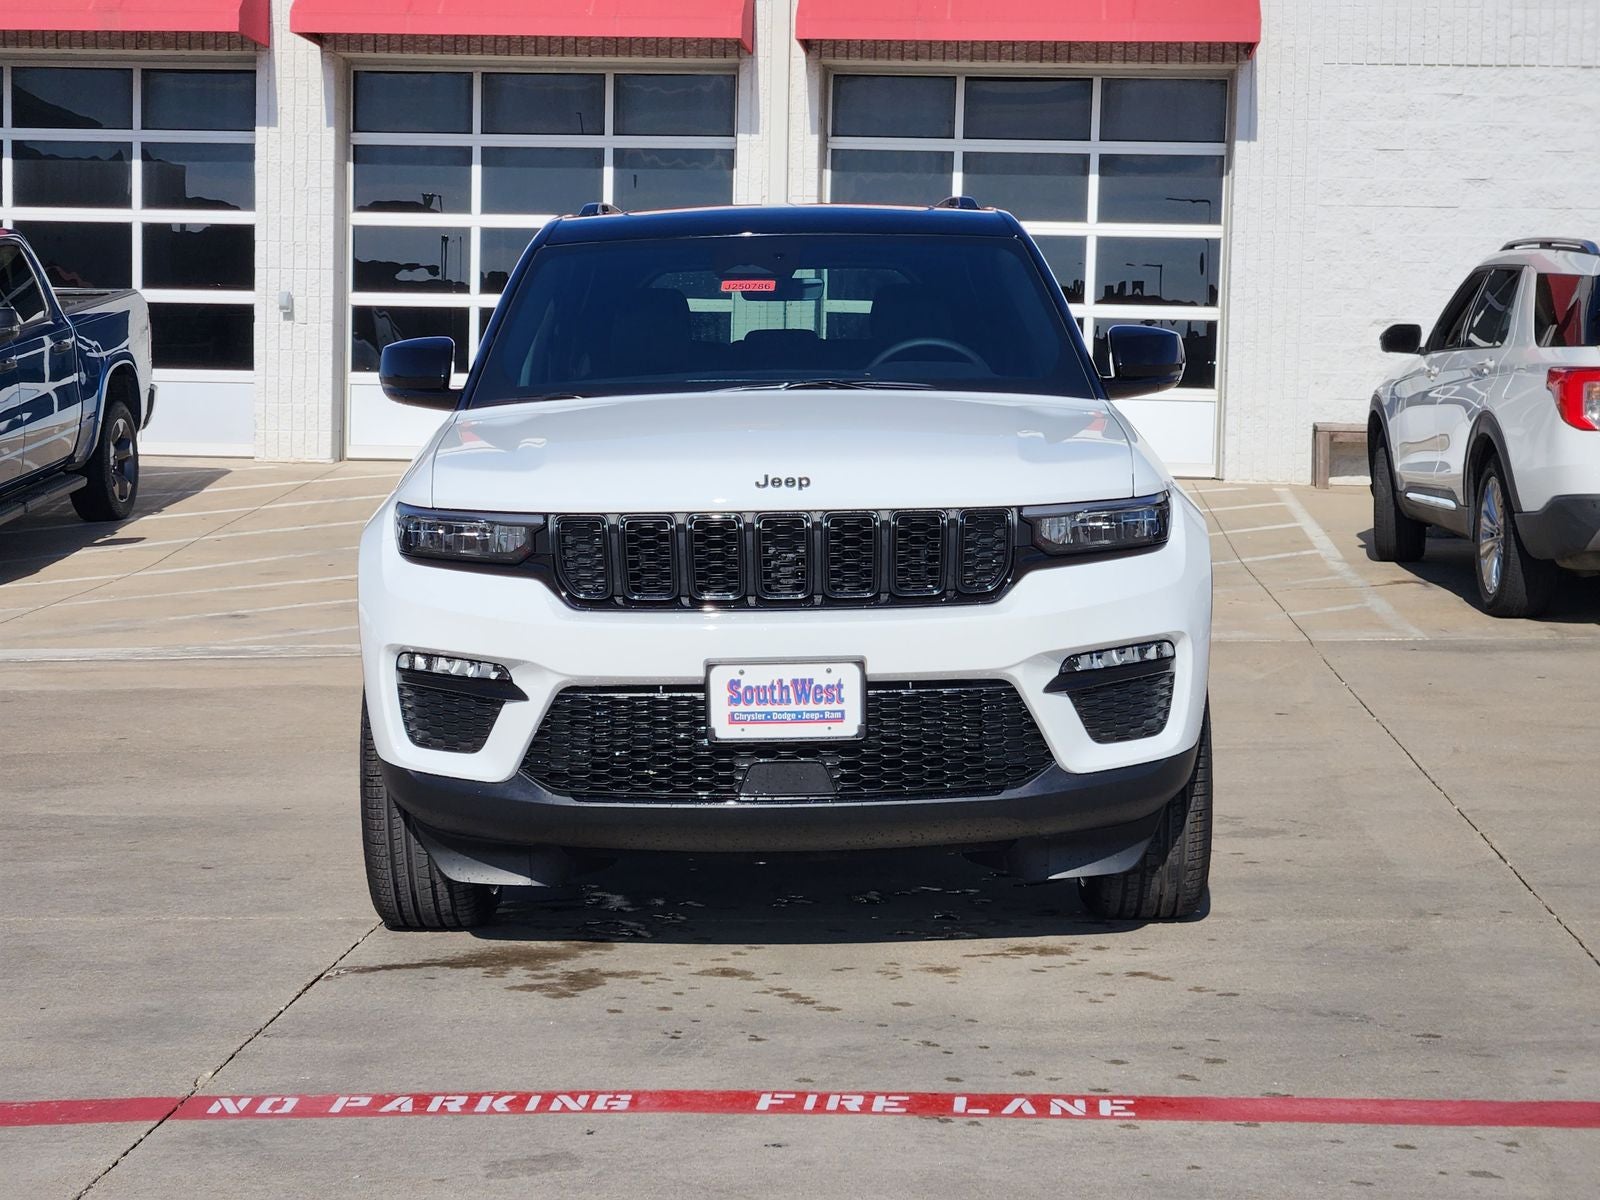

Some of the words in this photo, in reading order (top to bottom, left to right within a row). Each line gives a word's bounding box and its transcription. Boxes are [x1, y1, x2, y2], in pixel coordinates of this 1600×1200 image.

[755, 474, 811, 491] Jeep
[727, 678, 845, 706] SouthWest
[734, 712, 765, 721] Chrysler
[772, 712, 796, 721] Dodge
[802, 712, 819, 720] Jeep
[825, 711, 841, 719] Ram
[206, 1097, 299, 1114] NO
[328, 1094, 632, 1113] PARKING
[756, 1093, 909, 1112] FIRE
[953, 1097, 1136, 1117] LANE
